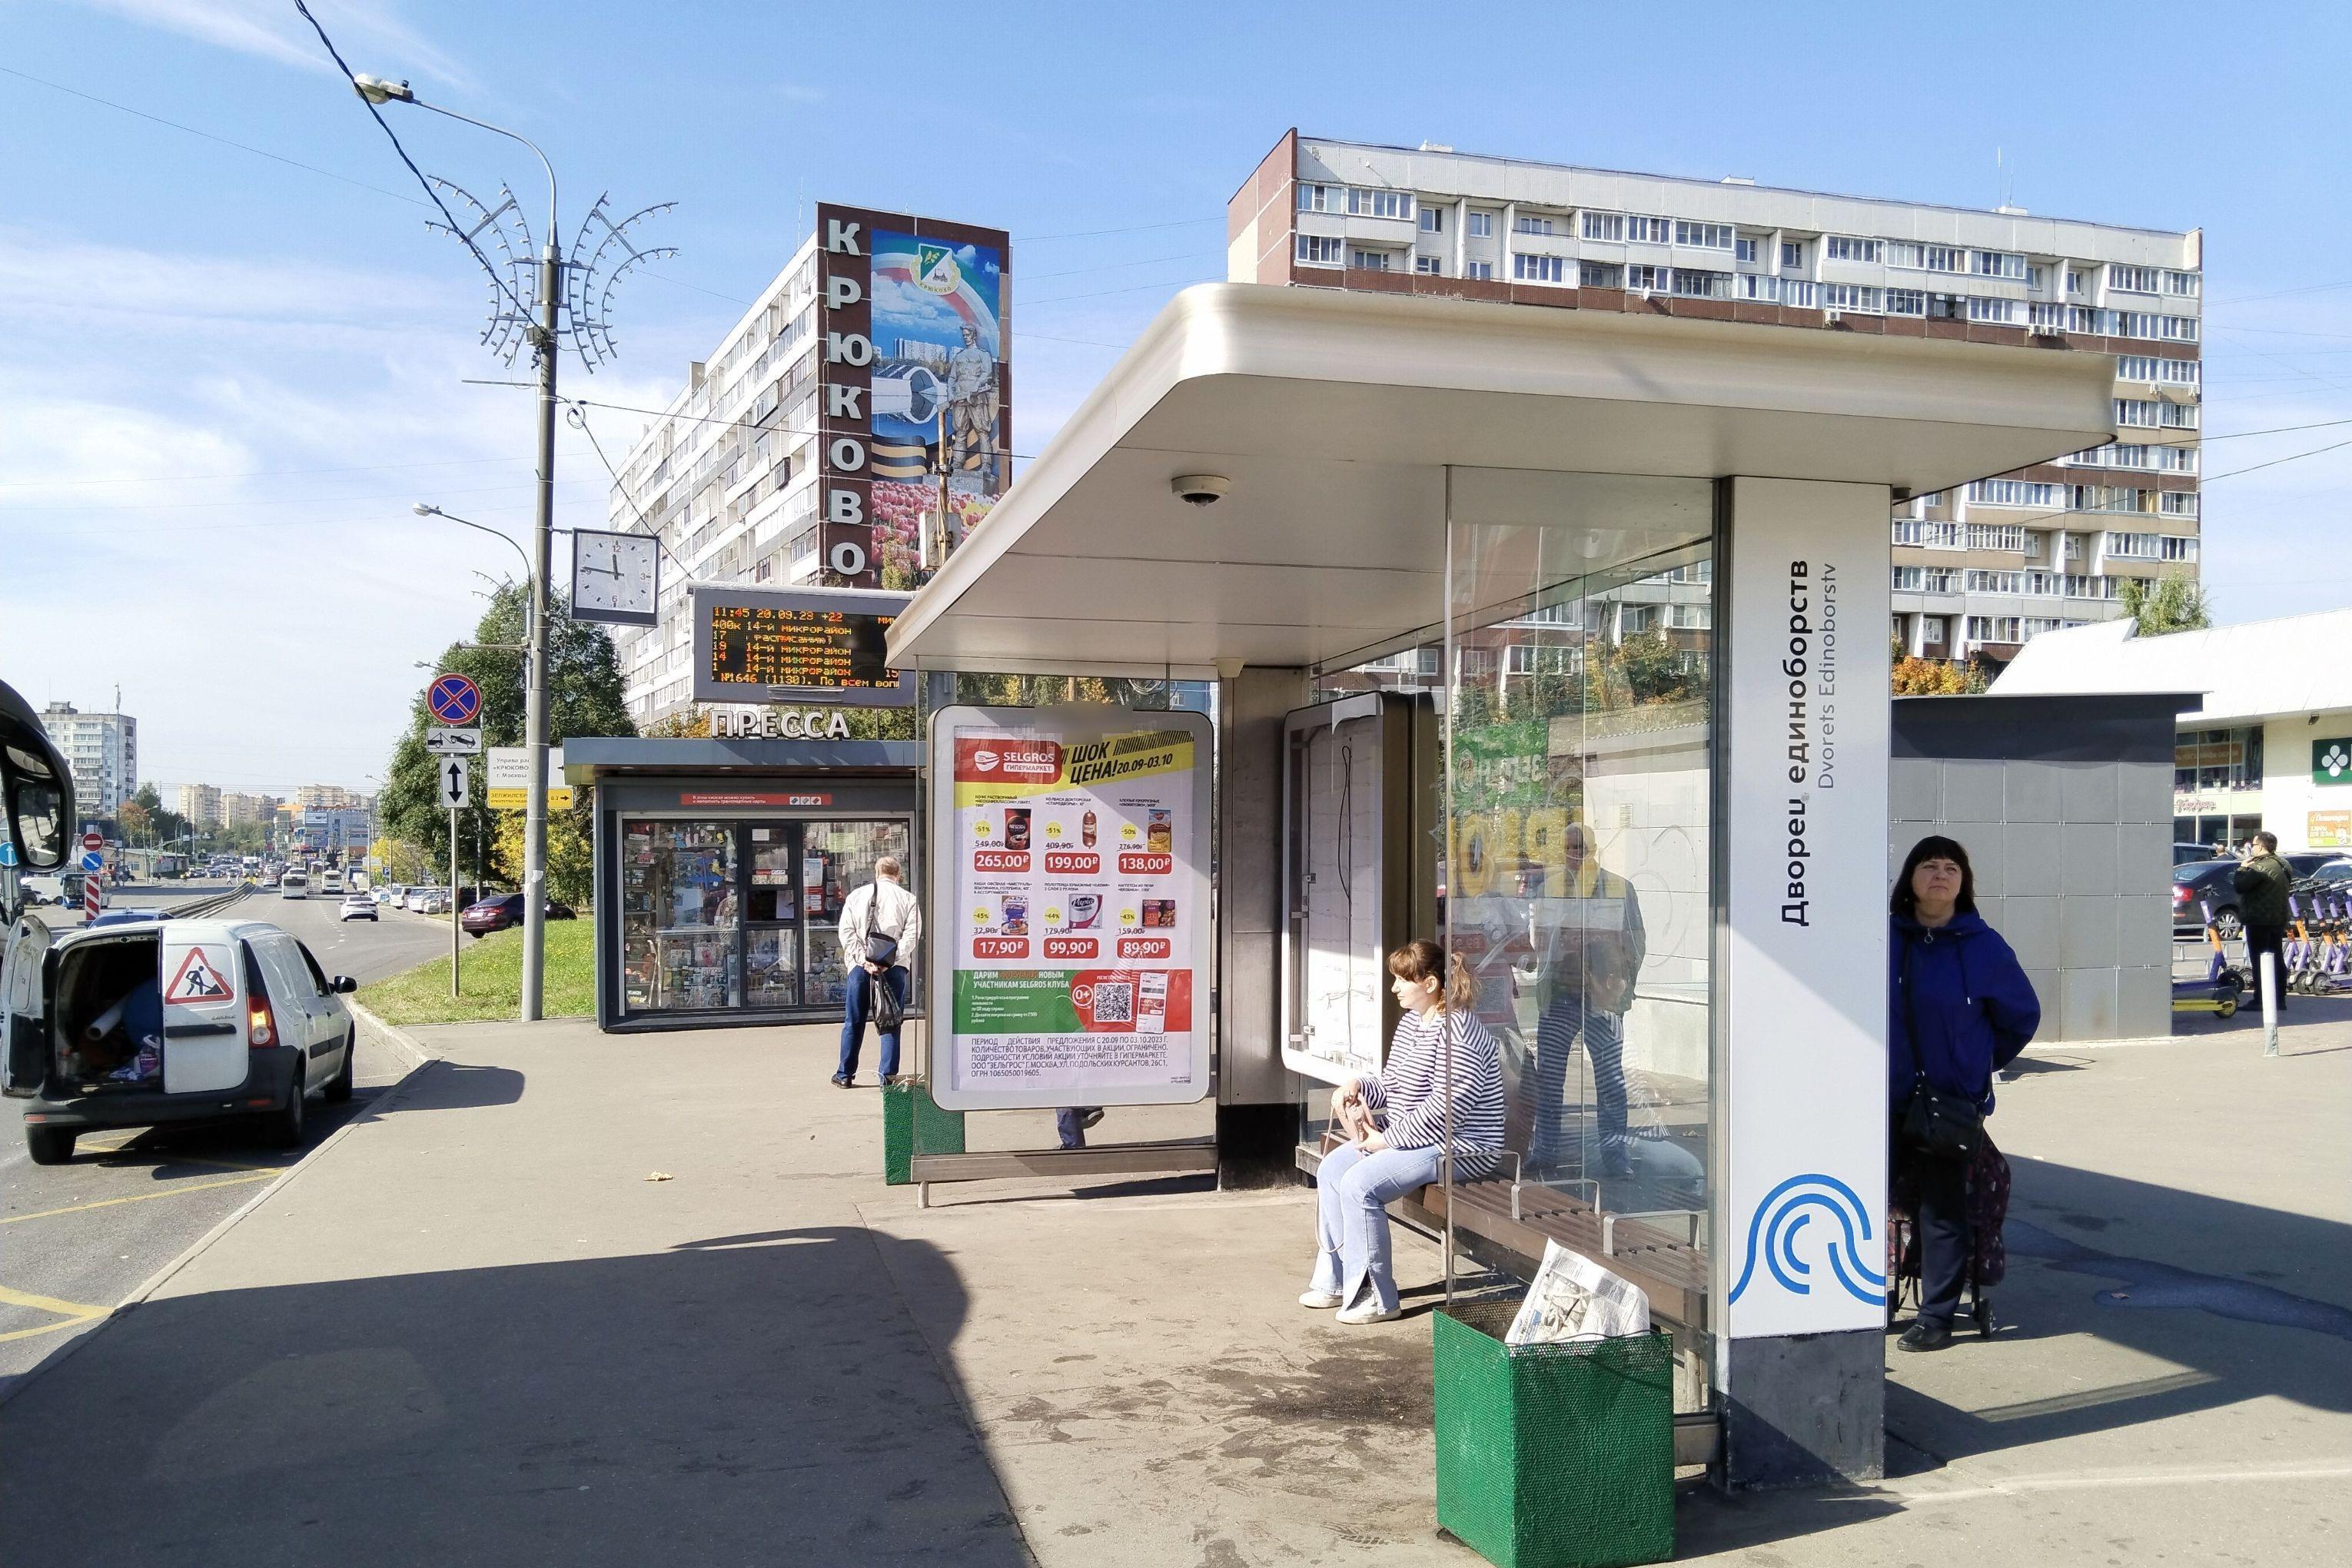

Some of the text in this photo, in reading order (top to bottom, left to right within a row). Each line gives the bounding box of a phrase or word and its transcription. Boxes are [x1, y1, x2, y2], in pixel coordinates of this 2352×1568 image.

[828, 219, 872, 575] КРЮКОВО
[714, 607, 750, 617] 11:45
[756, 609, 814, 620] 20.09.23
[821, 612, 843, 622] +22
[712, 620, 851, 635] 400к 14-й микрорайон
[713, 630, 727, 640] 17
[746, 642, 775, 653] 14-й
[781, 646, 851, 655] микрорайон
[713, 651, 851, 666] 14 14-й микрорайон
[713, 662, 718, 671] 1
[746, 663, 774, 673] 14-й
[781, 667, 851, 676] микрорайон
[1818, 563, 1836, 789] Dvorets Edinoborstv
[721, 673, 757, 683] №1646
[765, 674, 811, 685] (1130).
[820, 676, 834, 685] По
[841, 679, 869, 687] всем
[711, 710, 850, 739] ПРЕССА
[1782, 560, 1813, 927] Дворец единоборств
[1003, 752, 1055, 762] SELGROS
[1071, 741, 1111, 765] ШОК
[1070, 753, 1173, 786] ЦЕНА! 20.09-03.10
[976, 855, 1029, 869] 265,00₽
[1048, 857, 1098, 870] 199,00₽
[1121, 858, 1170, 871] 138,00₽
[980, 941, 1023, 955] 17,90₽
[1050, 942, 1093, 955] 99,90₽
[1076, 990, 1090, 999] 0+
[1007, 1037, 1040, 1045] ДЕЙСТВИЯ
[1022, 1052, 1052, 1060] УСЛОВИЙ
